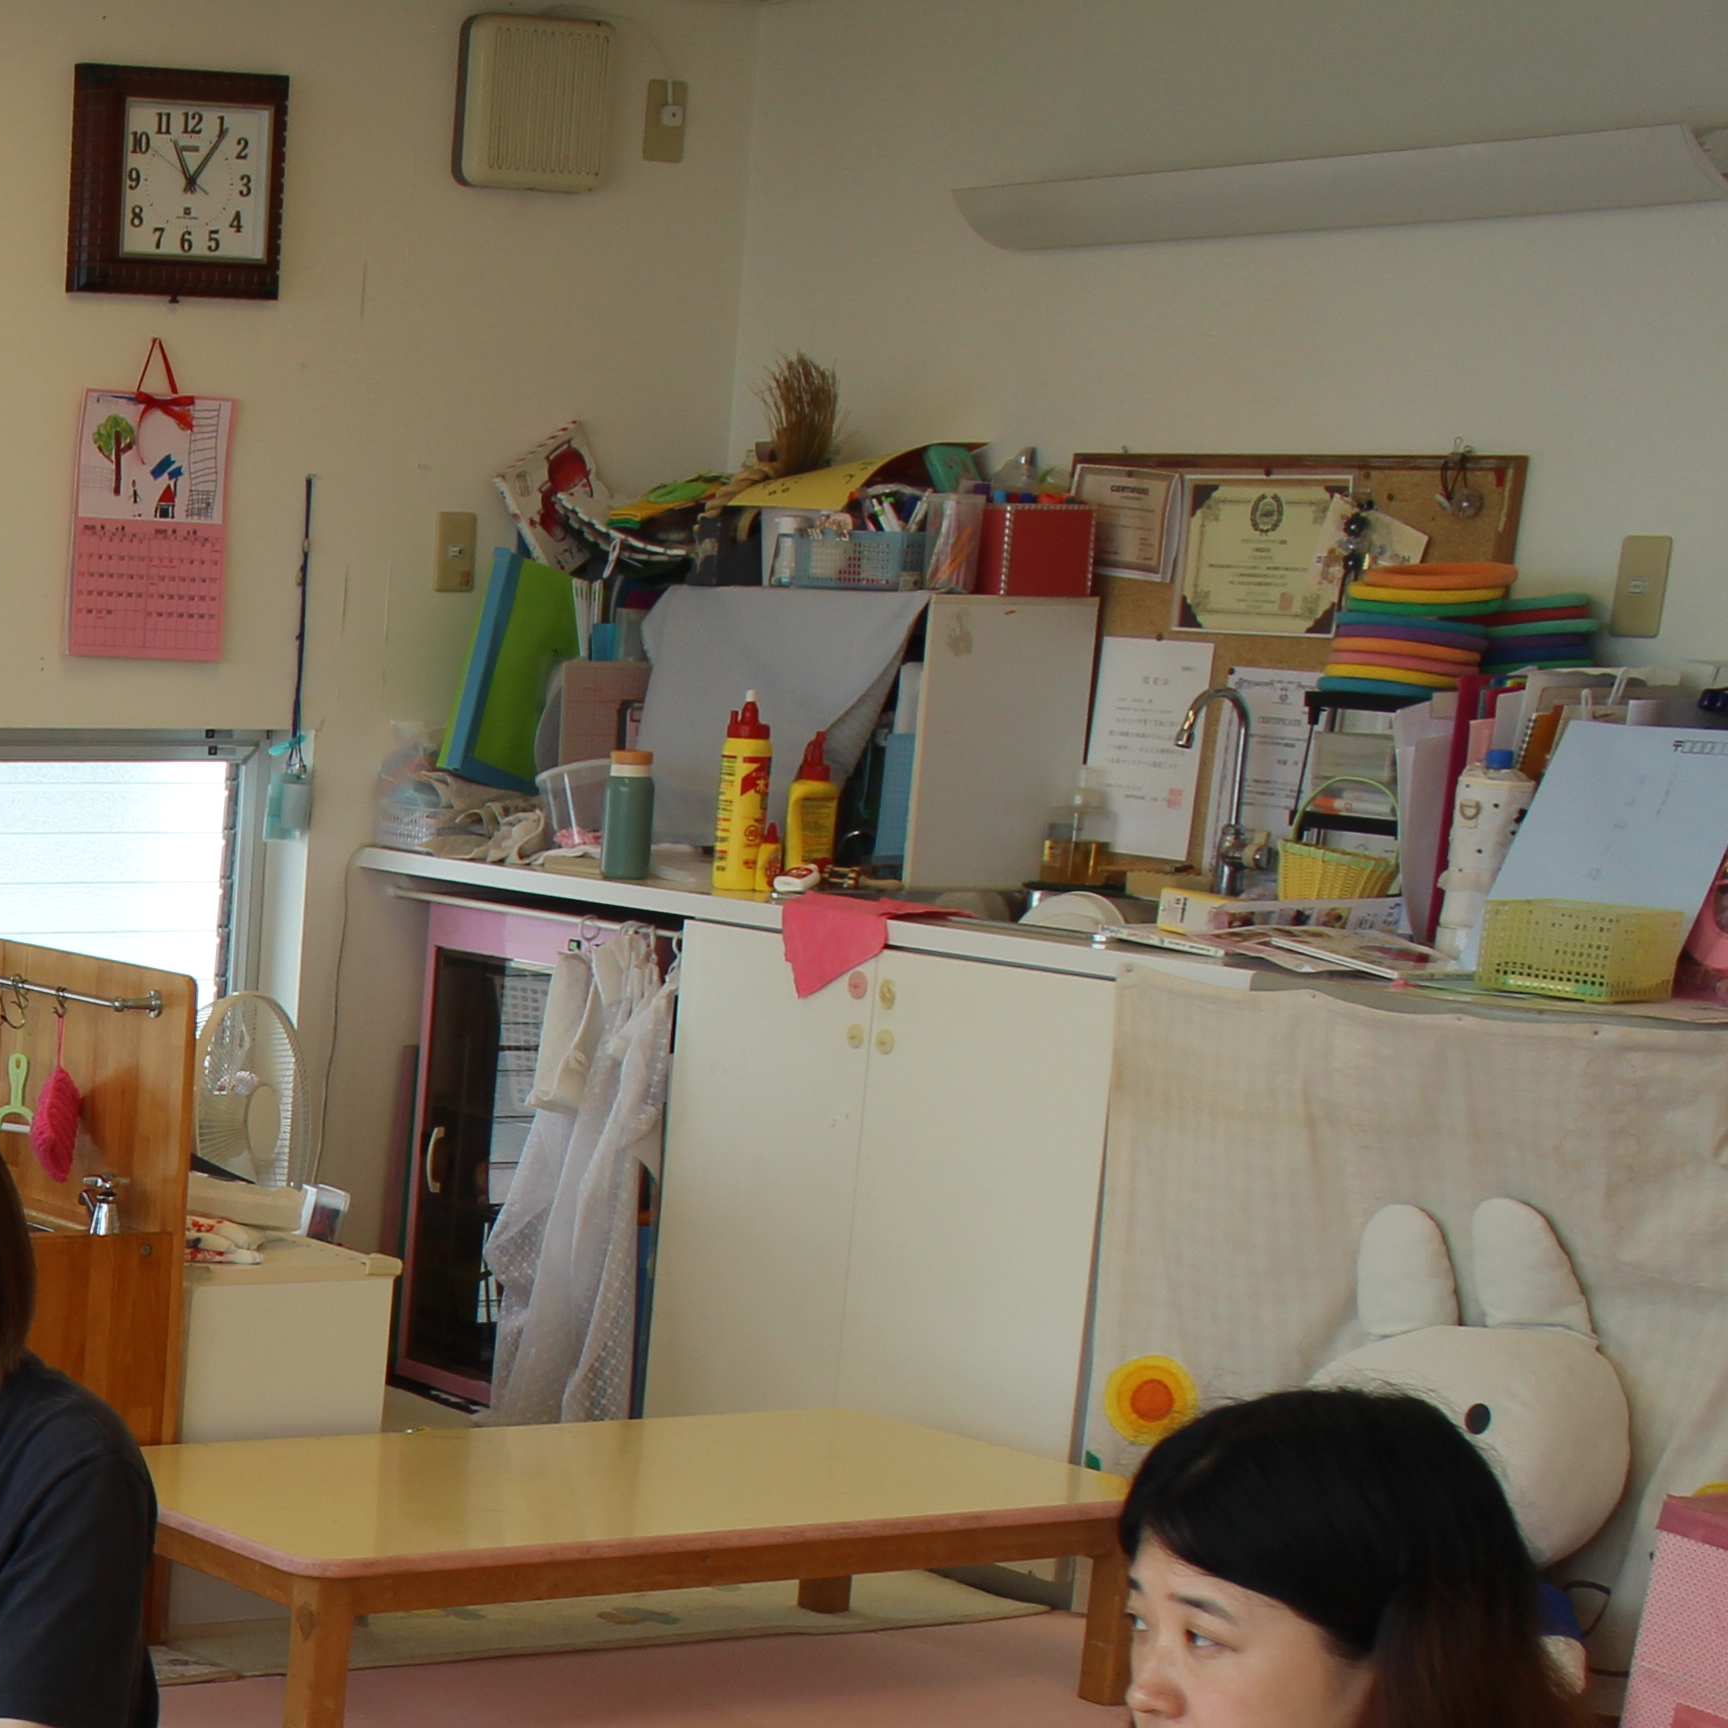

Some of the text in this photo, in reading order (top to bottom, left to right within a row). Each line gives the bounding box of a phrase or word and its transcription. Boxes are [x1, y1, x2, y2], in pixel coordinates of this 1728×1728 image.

[155, 111, 172, 135] 11
[181, 111, 203, 135] 12
[130, 131, 150, 154] 10
[236, 137, 249, 160] 2
[128, 167, 141, 190] 9
[239, 174, 252, 197] 3
[130, 205, 144, 228] 8
[229, 210, 244, 233] 4
[152, 227, 165, 249] 7
[180, 230, 193, 253] 6
[207, 229, 220, 252] 5
